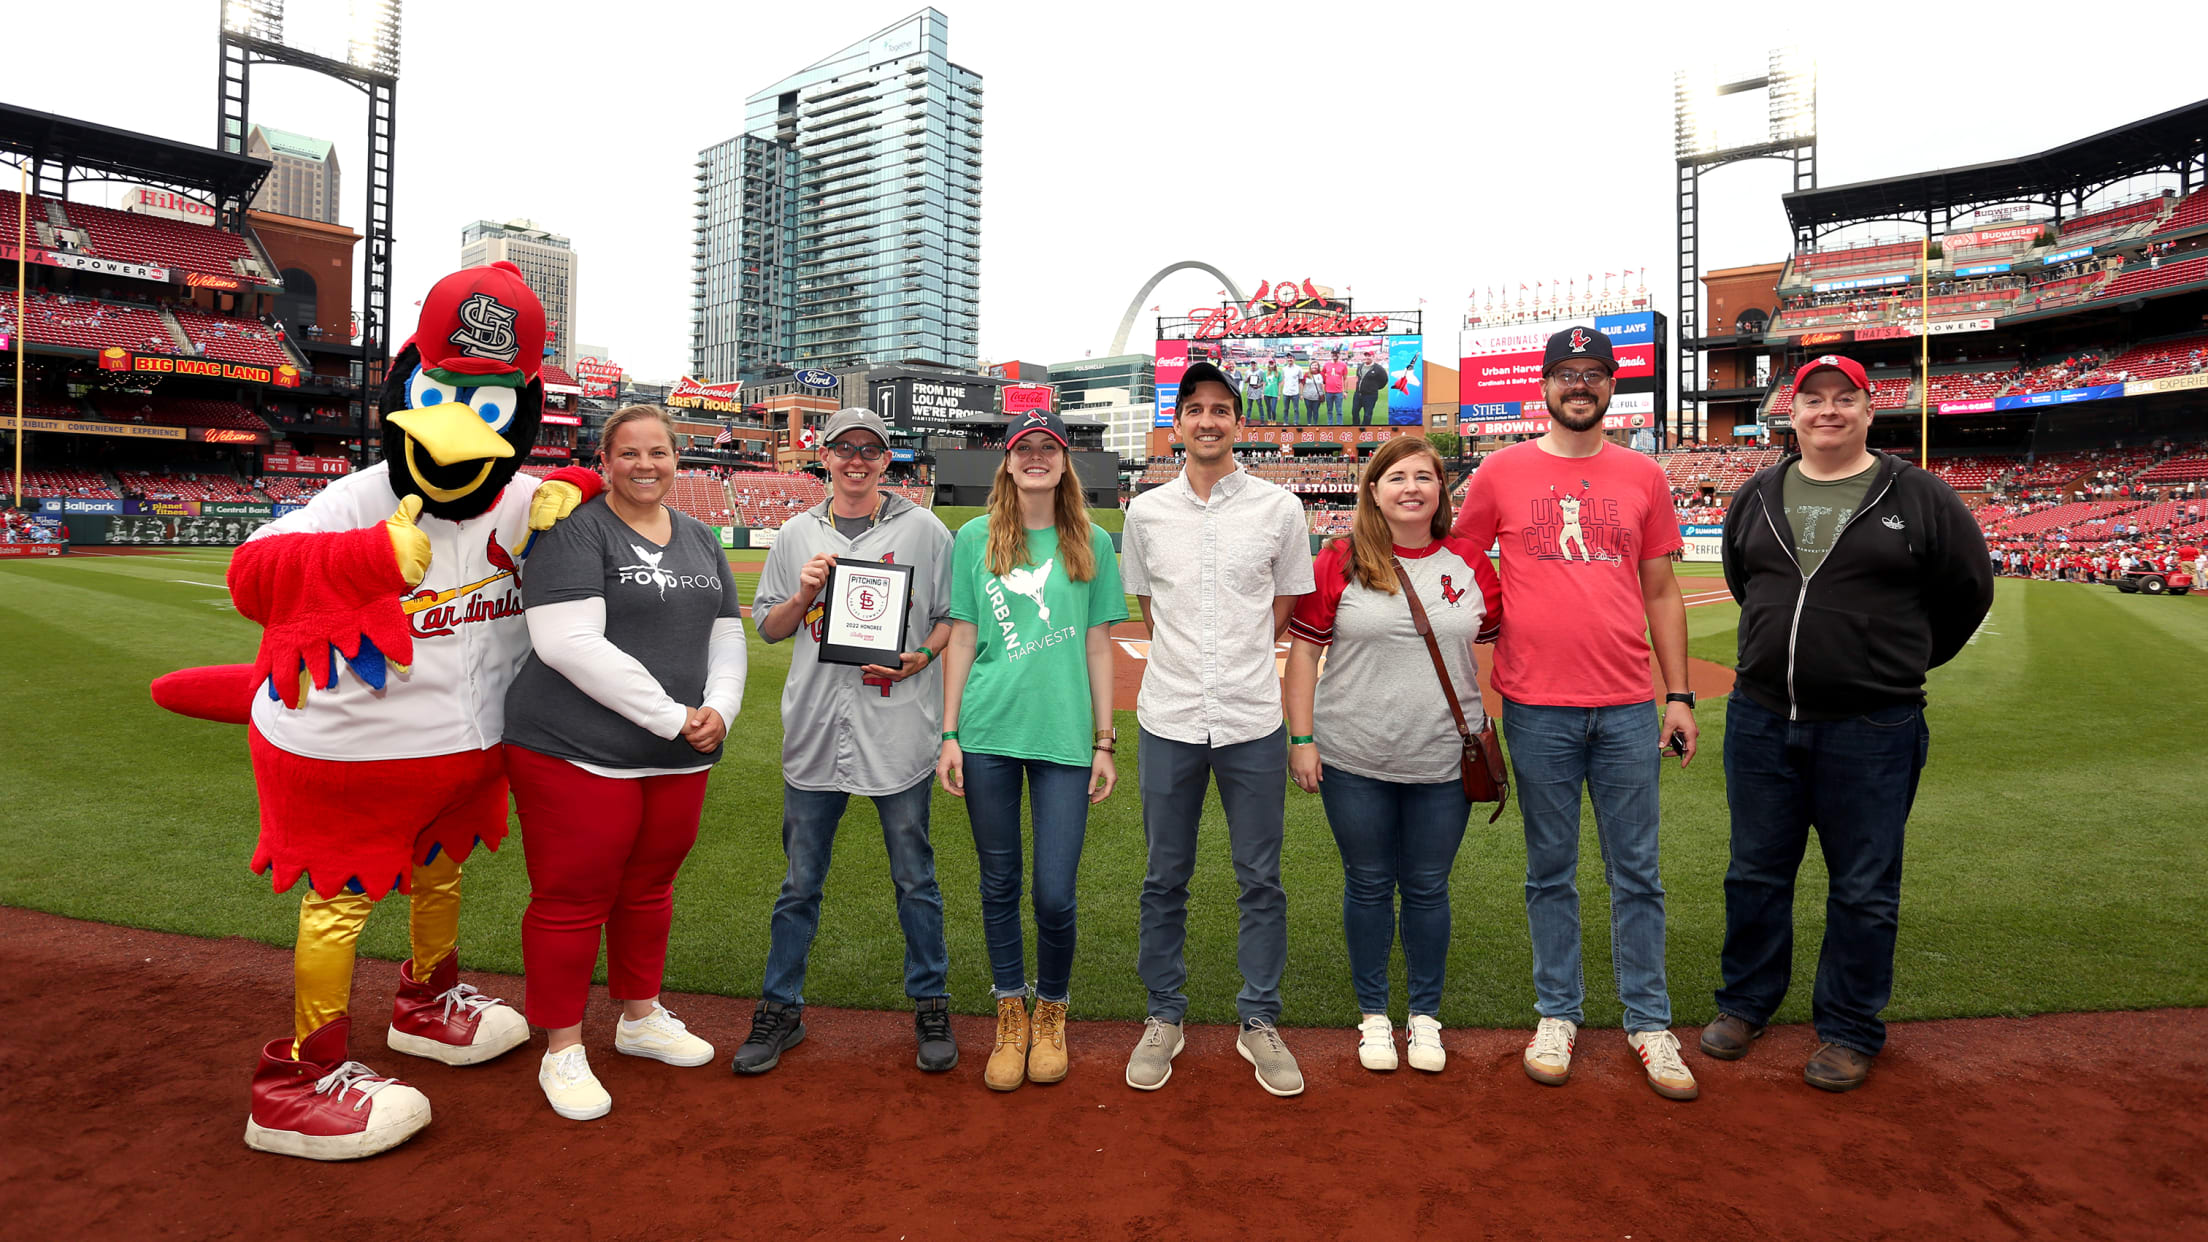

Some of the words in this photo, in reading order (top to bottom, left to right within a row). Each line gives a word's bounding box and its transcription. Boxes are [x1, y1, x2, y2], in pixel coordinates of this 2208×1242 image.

[139, 189, 215, 217] Hilton
[1974, 204, 2031, 217] BUDWEISER
[1981, 227, 2039, 240] BUDWEISER
[77, 258, 146, 276] POWER
[186, 272, 238, 288] Welcome
[1188, 307, 1388, 339] Budweiser
[1601, 325, 1622, 335] BLUE
[1623, 323, 1646, 334] JAYS
[1801, 332, 1842, 346] Welcome
[1856, 327, 1891, 339] THAT'S
[1490, 334, 1538, 347] CARDINALS
[1617, 355, 1646, 367] dinals
[135, 357, 173, 372] BIG
[176, 359, 220, 376] MAC
[223, 364, 271, 383] LAND
[1482, 367, 1510, 376] Urban
[804, 371, 832, 385] Ford
[2127, 382, 2154, 393] REAL
[2160, 375, 2208, 389] EXPERIE
[671, 381, 740, 398] Budweiser
[912, 383, 944, 395] FROM
[946, 386, 966, 398] THE
[668, 396, 701, 408] BREW
[704, 400, 742, 413] HOUSE
[912, 394, 934, 405] LOU
[936, 396, 959, 407] AND
[912, 405, 946, 417] WE'RE
[948, 408, 984, 418] PROU
[1472, 404, 1508, 416] STIFEL
[7, 419, 58, 430] FLXIBILITY
[67, 423, 125, 434] CONVENIENCE
[132, 428, 180, 437] EXPERIENCE
[1485, 422, 1534, 433] BROWN
[1536, 423, 1545, 431] &
[204, 428, 257, 443] Welcome
[1248, 432, 1259, 442] 14
[1264, 432, 1275, 442] 17
[1281, 432, 1294, 442] 20
[1302, 432, 1314, 442] 23
[1320, 432, 1334, 442] 24
[1339, 432, 1353, 442] 42
[1359, 432, 1373, 442] 45
[1377, 432, 1391, 442] 85
[64, 501, 115, 512] Ballpark
[152, 502, 183, 511] planet
[216, 505, 247, 514] Central
[249, 506, 271, 514] Bank
[1531, 498, 1621, 526] UNCLE
[1683, 543, 1720, 555] PERFIC
[680, 574, 722, 592] ROO
[851, 576, 881, 585] PITCHING
[407, 588, 524, 639] Cardinals
[985, 578, 1021, 650] URBAN
[1008, 627, 1069, 662] HARVEST
